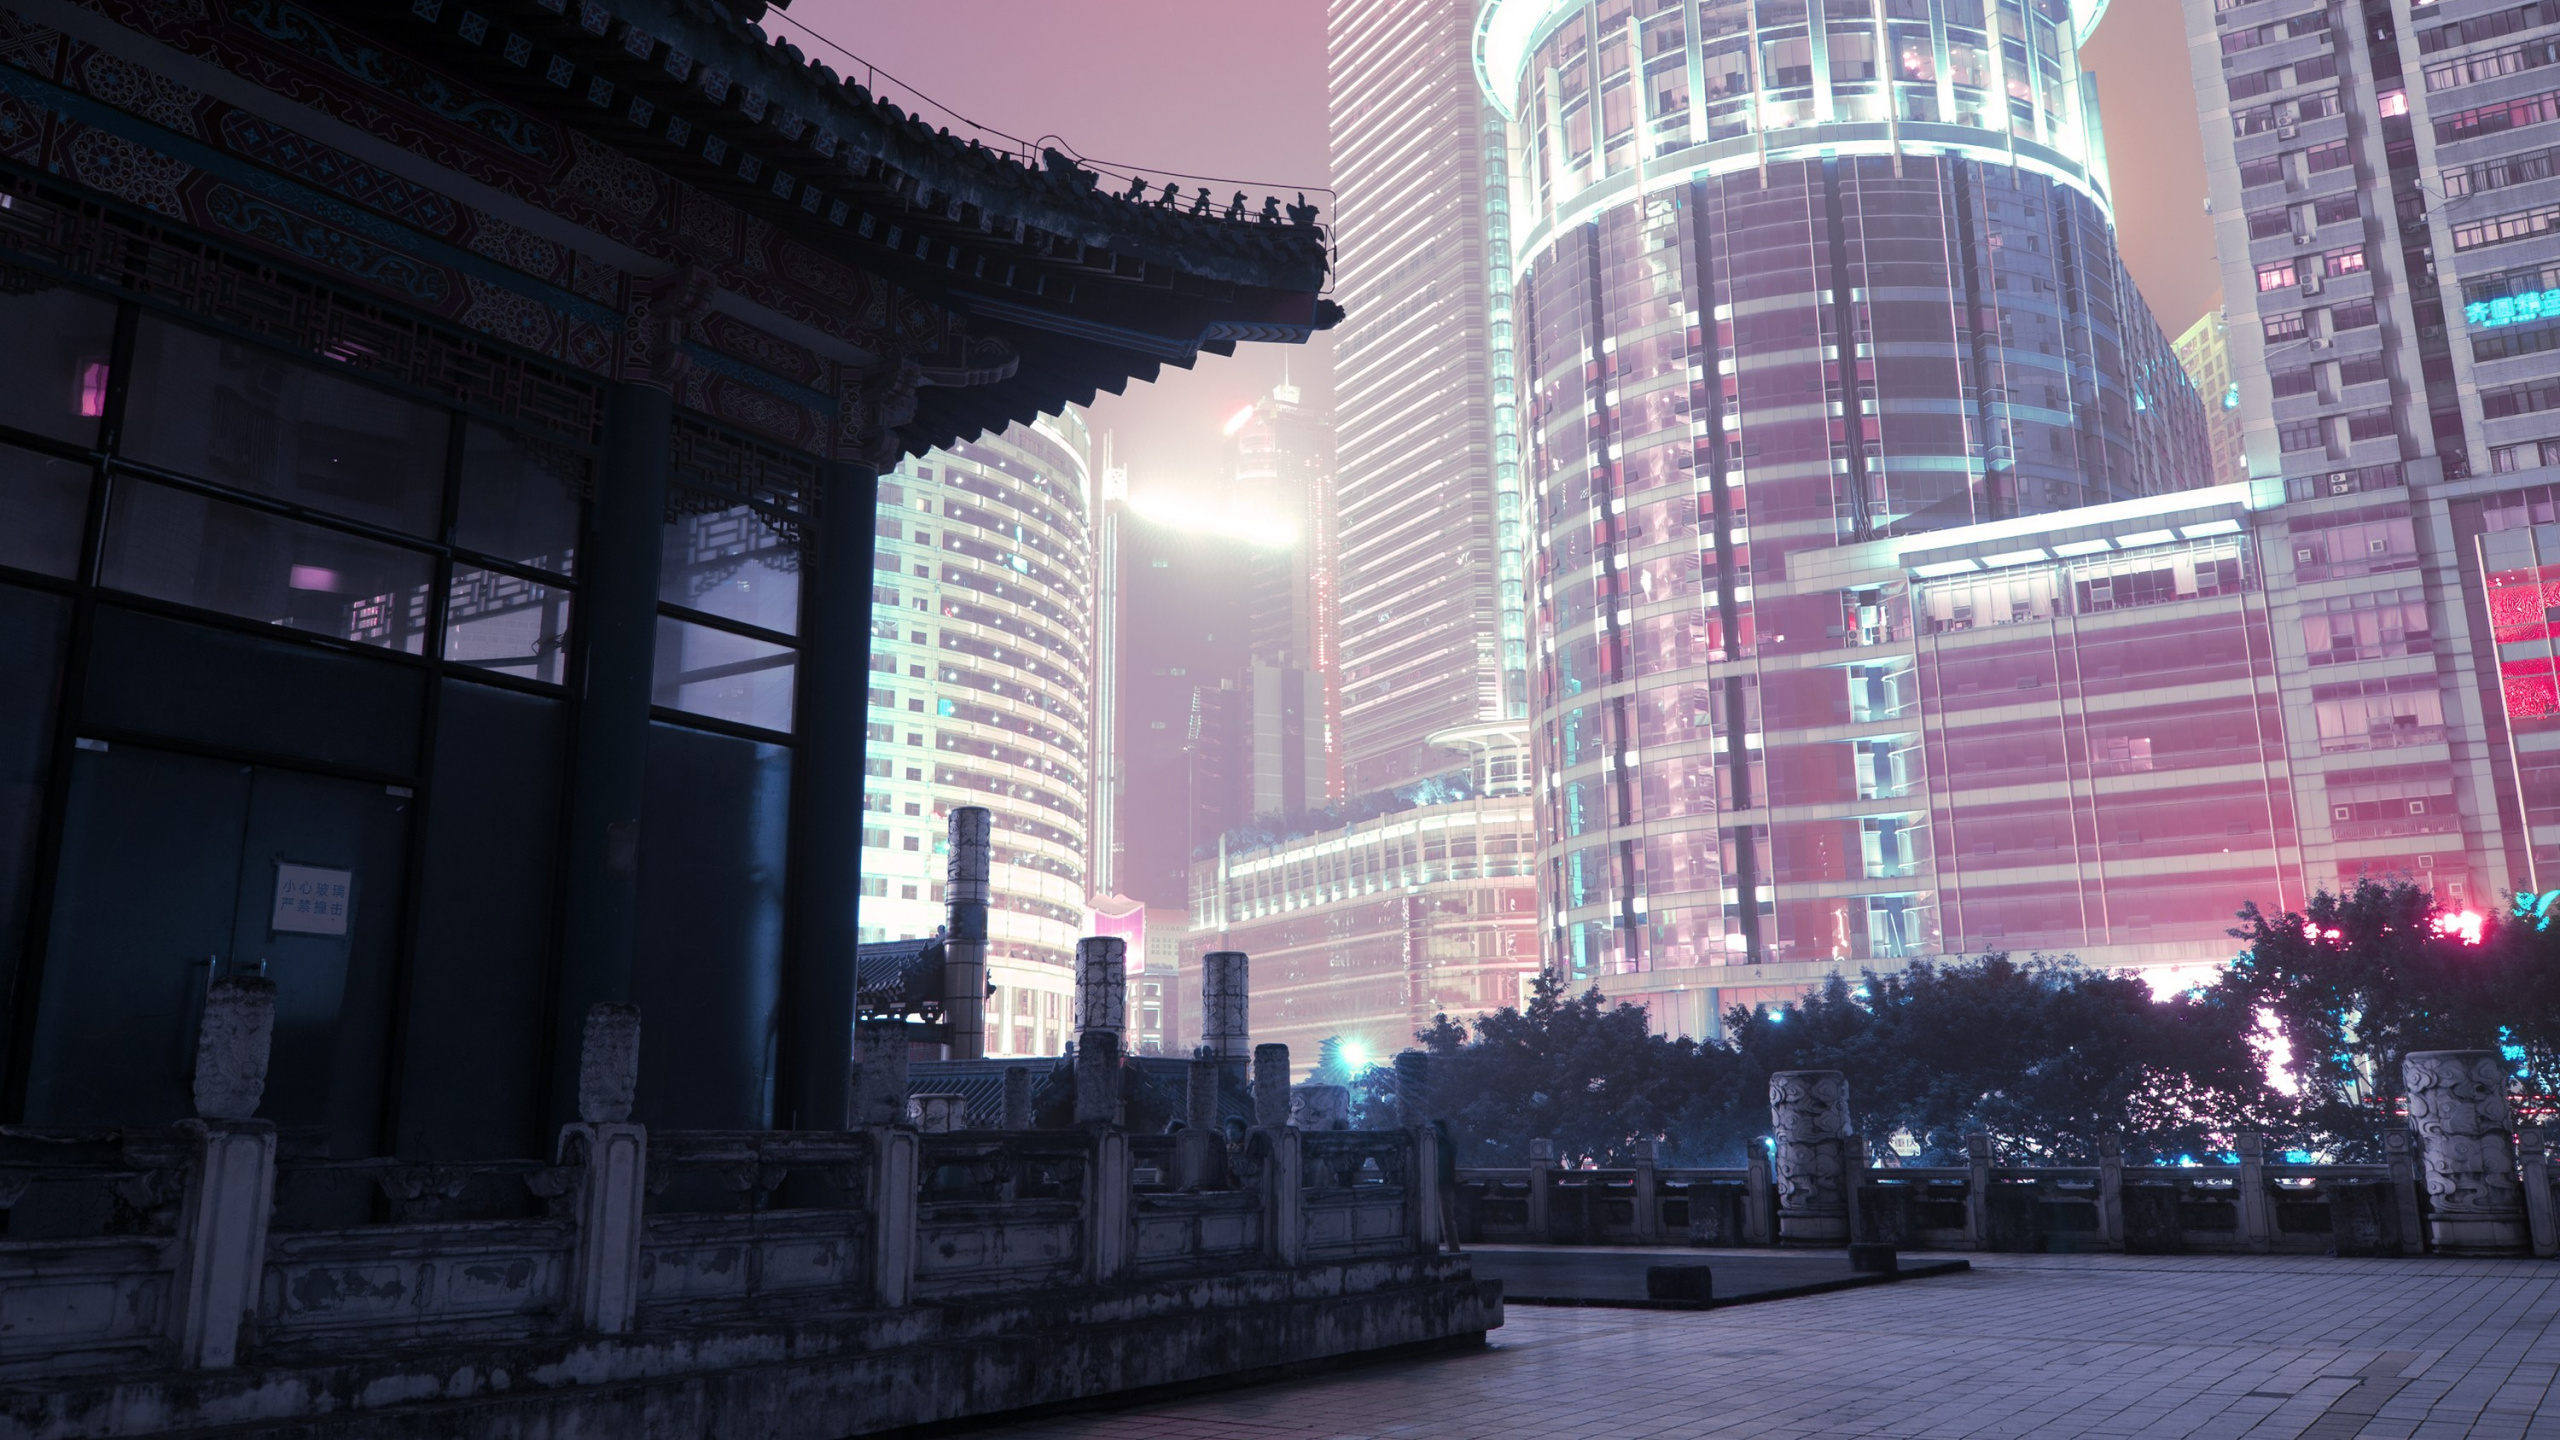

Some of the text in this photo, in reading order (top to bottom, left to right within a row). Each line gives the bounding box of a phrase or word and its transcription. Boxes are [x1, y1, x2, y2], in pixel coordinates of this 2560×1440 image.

[282, 879, 346, 899] 小心玻璃
[280, 896, 344, 917] 严禁撞击
